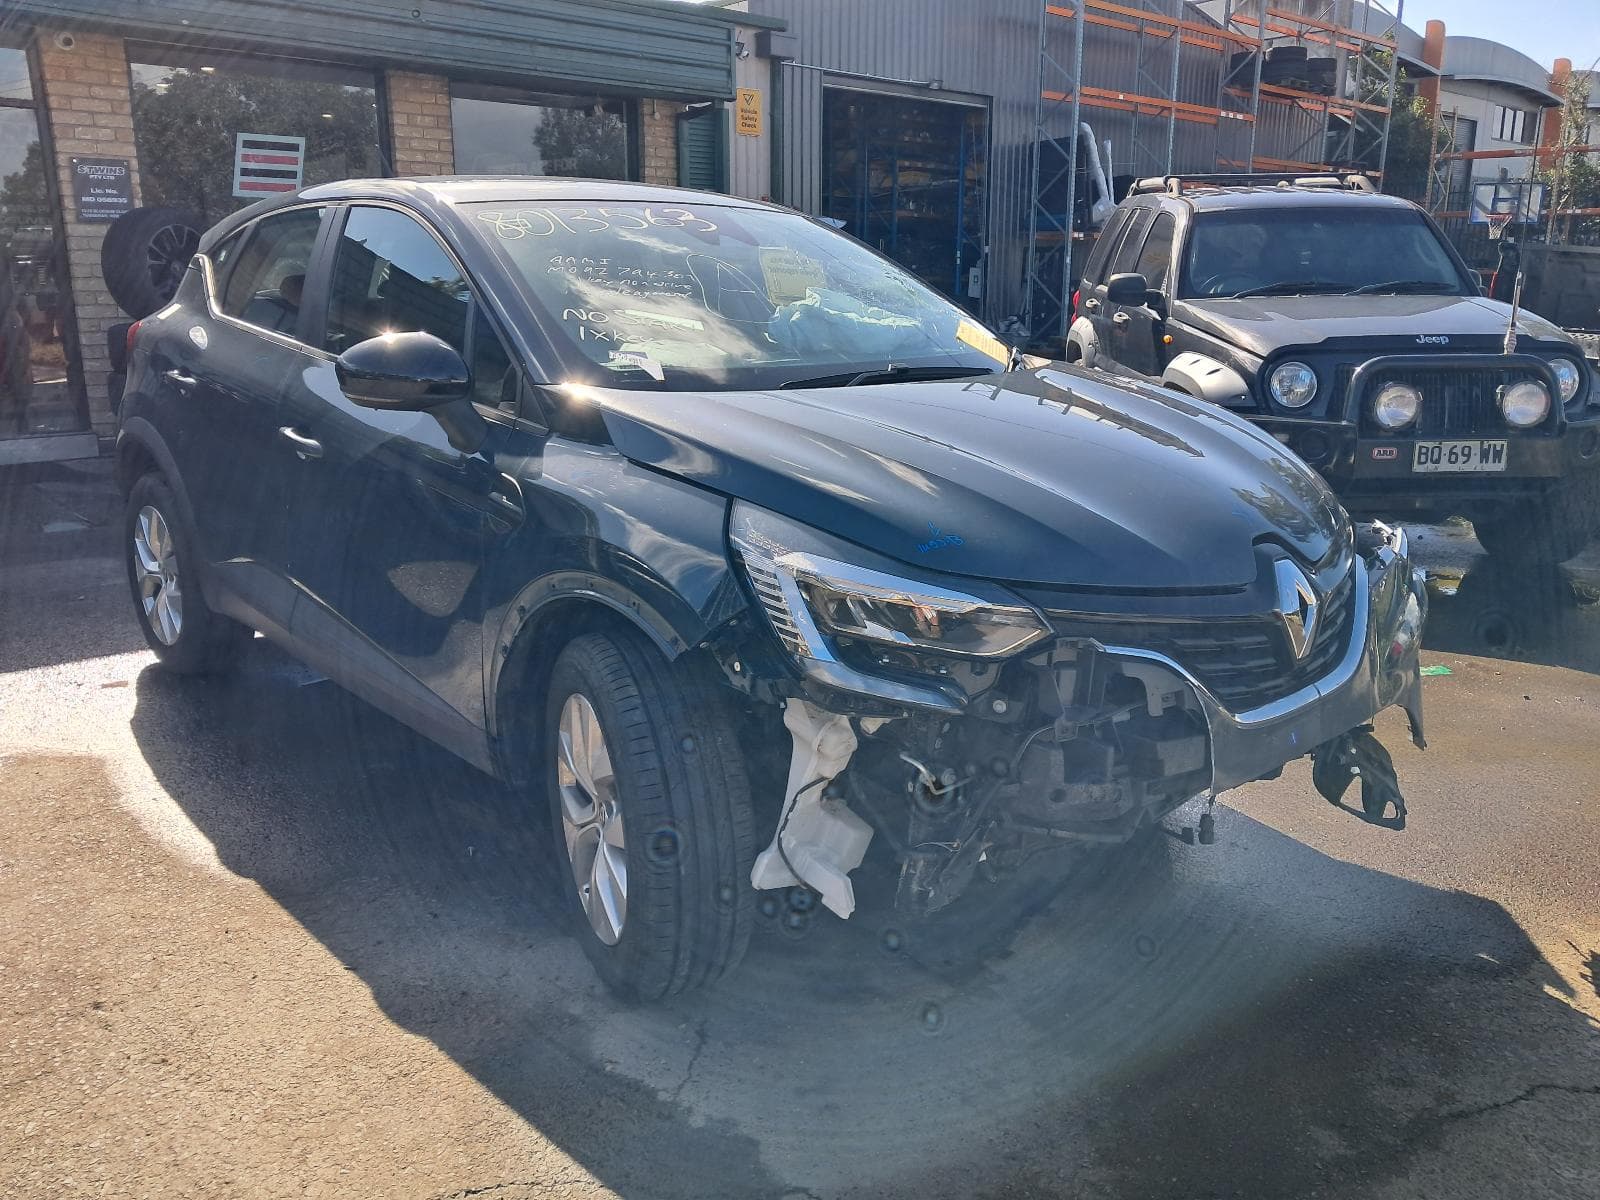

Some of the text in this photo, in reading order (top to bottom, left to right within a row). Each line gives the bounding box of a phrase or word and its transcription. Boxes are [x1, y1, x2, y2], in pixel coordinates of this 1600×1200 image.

[741, 121, 757, 129] Check
[563, 308, 610, 323] NO
[1416, 334, 1450, 345] Jeep
[1375, 449, 1395, 457] ARB
